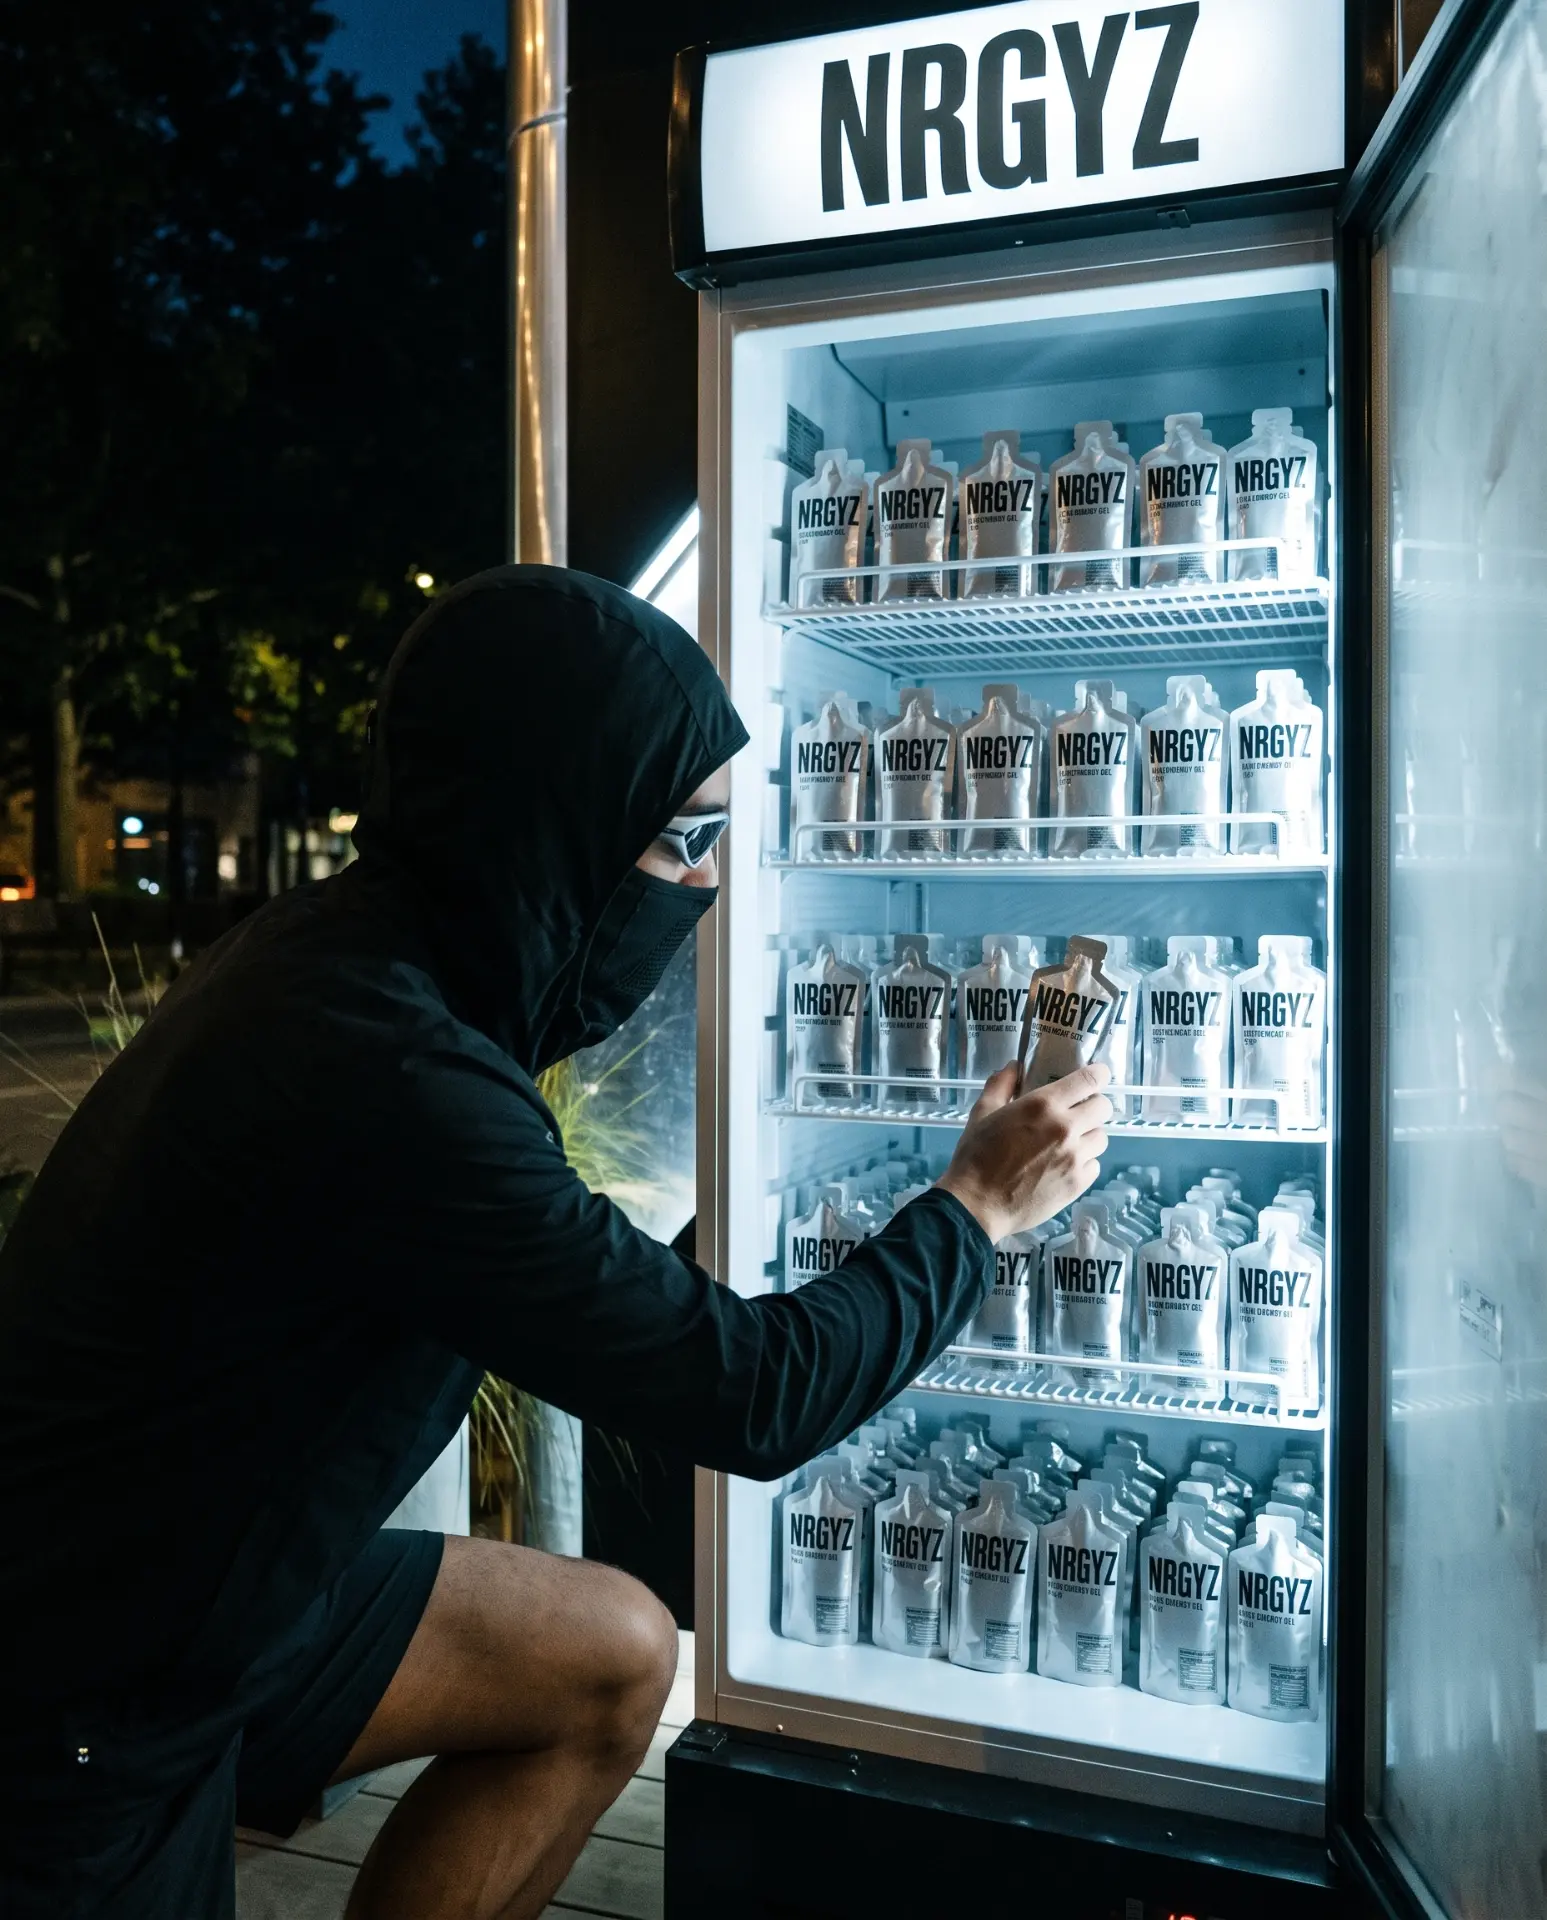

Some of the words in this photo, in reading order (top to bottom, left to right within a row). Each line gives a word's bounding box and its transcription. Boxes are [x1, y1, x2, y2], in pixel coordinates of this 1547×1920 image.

[820, 1, 1199, 212] NRGYZ
[1058, 471, 1125, 508] NRGYZ
[1148, 463, 1218, 501] NRGYZ
[1235, 457, 1307, 494] NRGYZ
[798, 496, 860, 529] NRGYZ
[881, 487, 945, 522] NRGYZ
[967, 479, 1033, 515] NRGYZ
[798, 741, 861, 774] NRGYZ
[882, 738, 948, 772] NRGYZ
[966, 735, 1033, 769] NRGYZ
[1058, 732, 1127, 766] NRGYZ
[1150, 728, 1221, 763] NRGYZ
[1240, 724, 1312, 759] NRGYZ
[794, 983, 857, 1016] NRGYZ
[879, 985, 944, 1020] NRGYZ
[1032, 984, 1109, 1035] NRGYZ
[1151, 991, 1222, 1026] NRGYZ
[1242, 991, 1315, 1028] NRGYZ
[995, 1251, 1031, 1287] GYZ
[1054, 1256, 1123, 1294] NRGYZ
[1239, 1267, 1312, 1308] NRGYZ
[790, 1513, 855, 1551] NRGYZ
[881, 1521, 944, 1562] NRGYZ
[961, 1531, 1029, 1574] NRGYZ
[1048, 1543, 1118, 1586] NRGYZ
[1149, 1556, 1220, 1601] NRGYZ
[1239, 1570, 1313, 1615] NRGYZ
